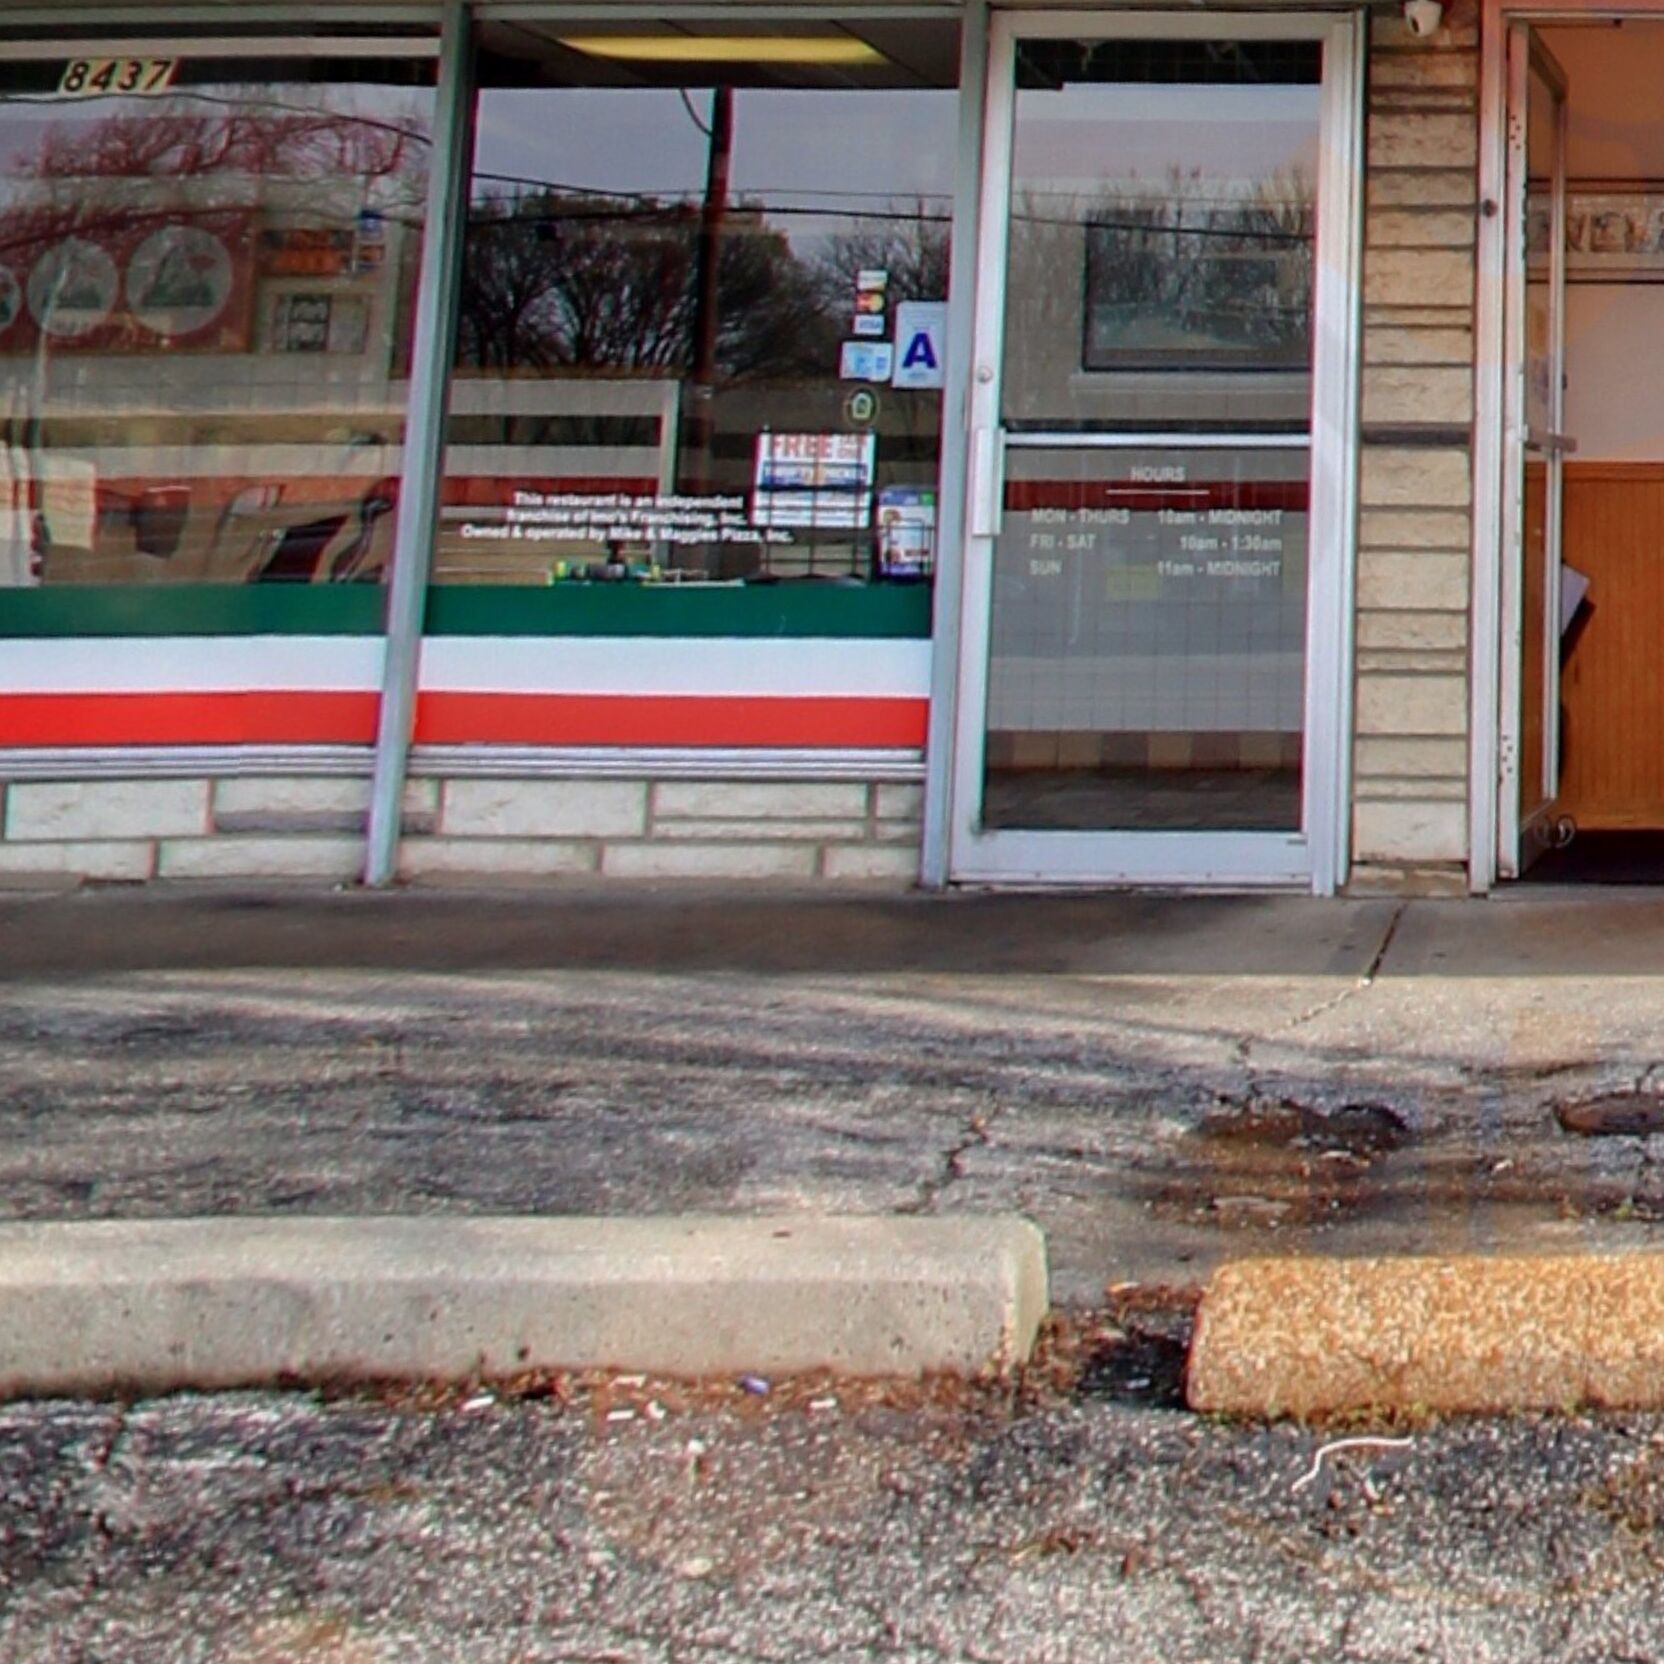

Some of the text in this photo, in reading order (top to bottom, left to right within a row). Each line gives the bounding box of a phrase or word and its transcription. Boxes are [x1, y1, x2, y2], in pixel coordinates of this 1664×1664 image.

[64, 59, 172, 93] 8437
[903, 332, 938, 369] A
[1131, 467, 1185, 481] HOURS
[514, 491, 543, 505] This
[545, 493, 616, 506] restaurant
[1031, 509, 1066, 524] MON
[1079, 509, 1130, 524] THURS
[1208, 509, 1283, 525] MIDNIGHT
[1030, 534, 1054, 548] FRI
[1067, 534, 1096, 549] SAT
[1030, 561, 1062, 575] SUN
[1207, 561, 1280, 576] MIDNIGHT
